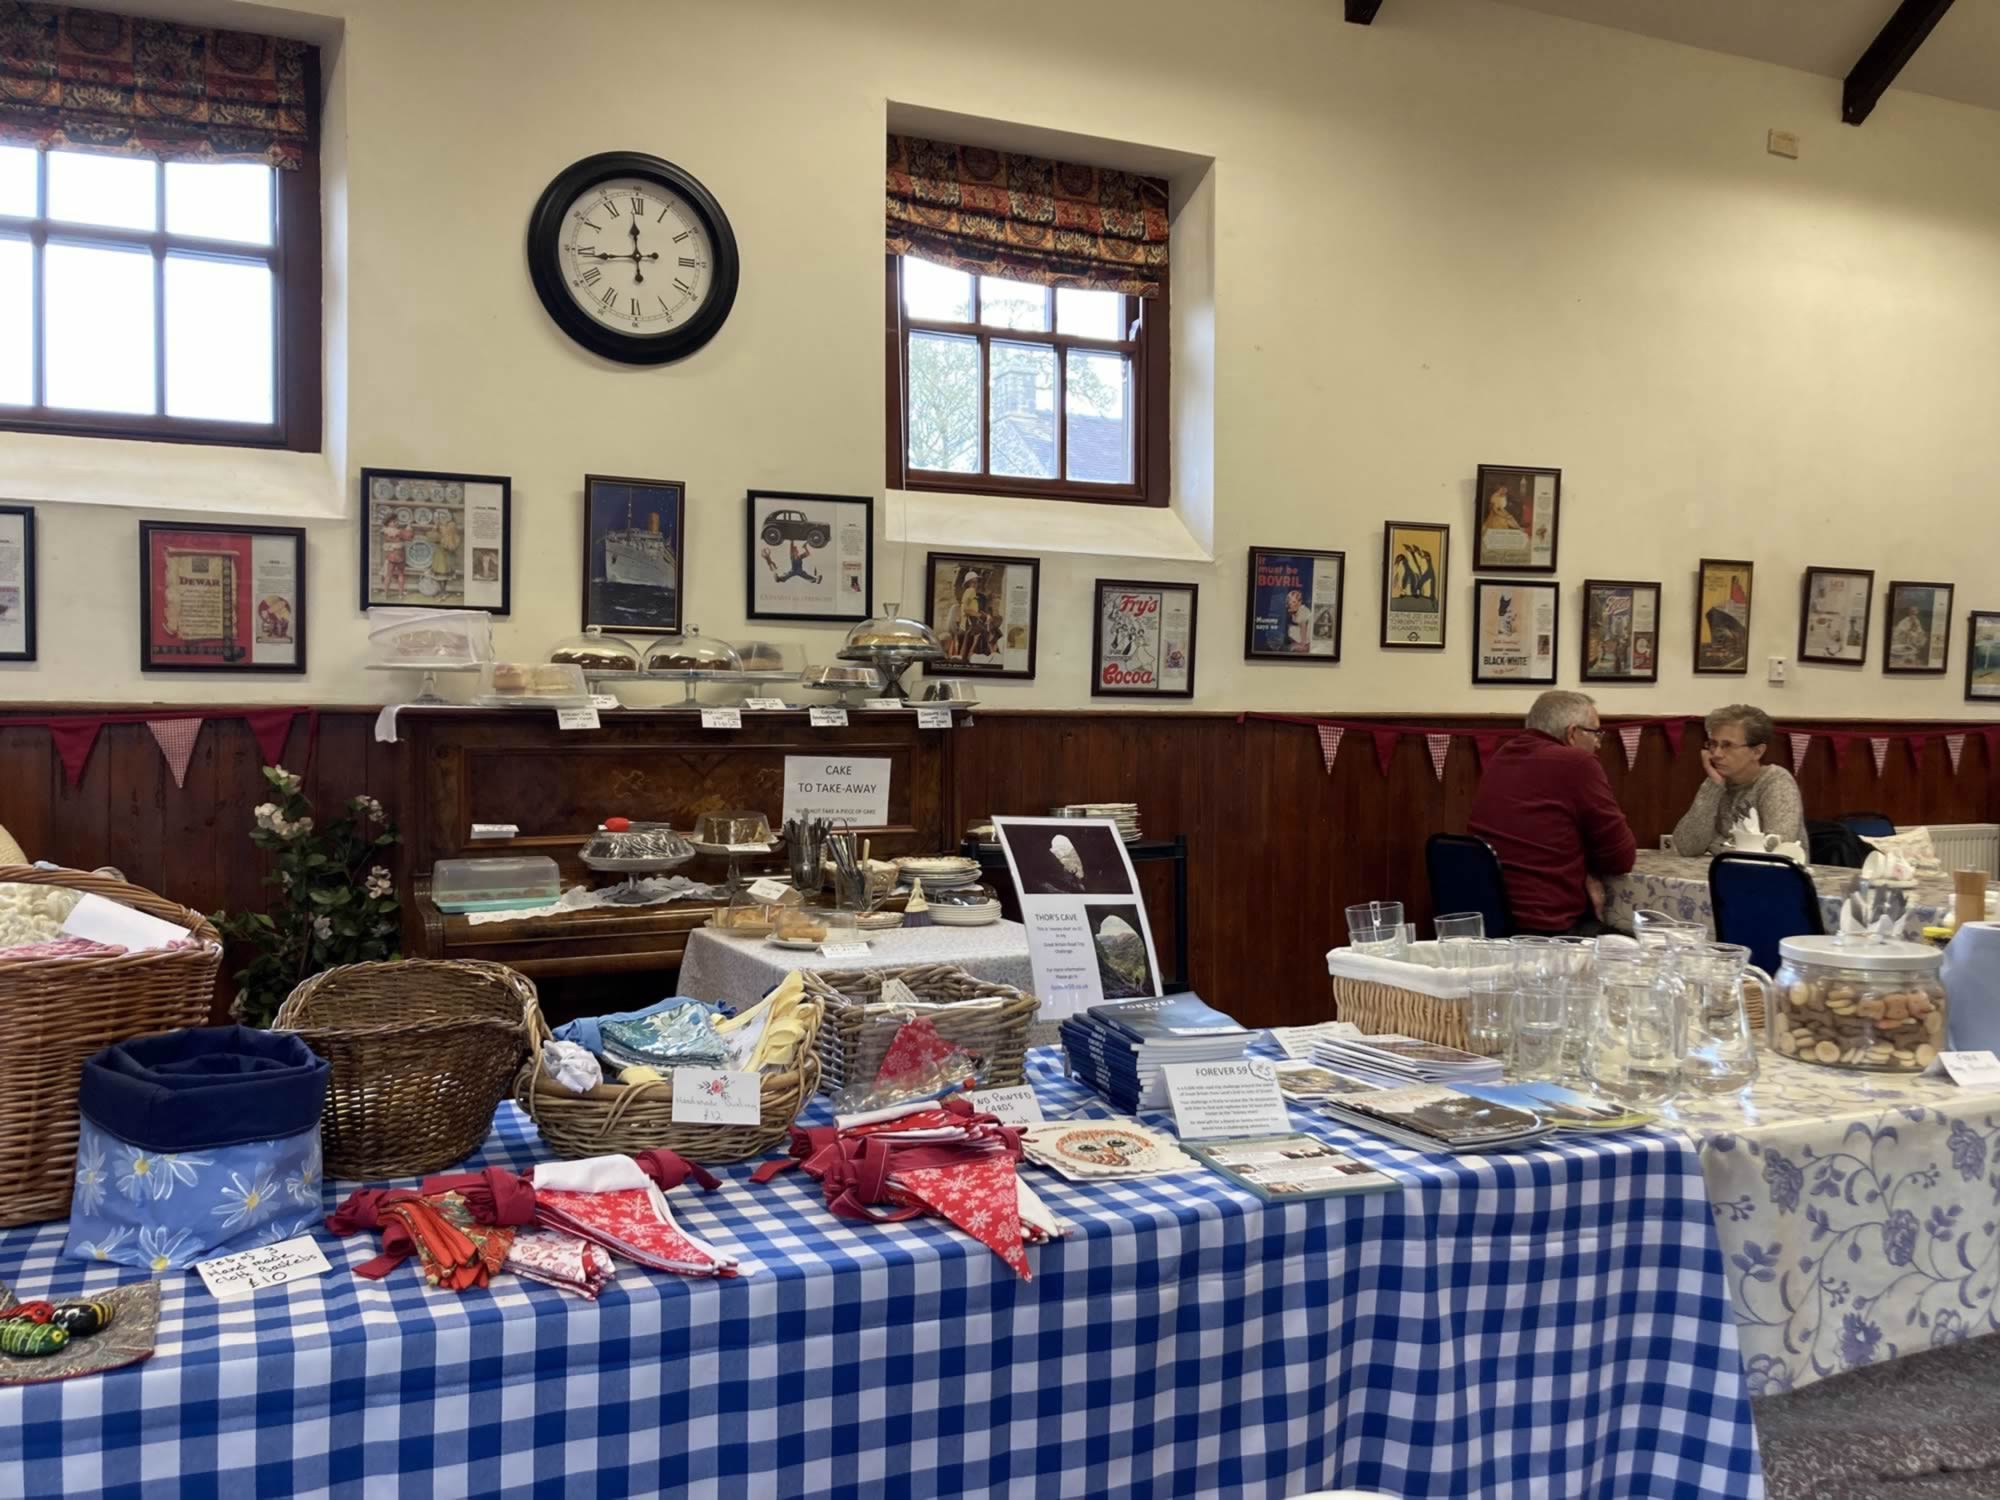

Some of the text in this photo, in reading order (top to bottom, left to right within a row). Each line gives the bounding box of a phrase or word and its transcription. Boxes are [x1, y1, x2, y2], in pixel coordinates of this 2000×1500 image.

[630, 198, 644, 216] XII
[672, 230, 690, 244] II
[678, 256, 696, 268] III
[1258, 575, 1303, 588] BOVRIL
[1120, 594, 1159, 617] Fry's
[1484, 656, 1505, 666] BLACK
[1102, 662, 1153, 685] Cocoa
[825, 765, 852, 776] CAKE
[798, 782, 878, 794] TO TAKE-AWAY
[1034, 913, 1078, 922] THOR'S CAVE
[1119, 1000, 1176, 1010] FOREVER
[1195, 1067, 1236, 1078] FOREVER
[1236, 1066, 1248, 1076] 59
[992, 1091, 1032, 1102] PAINTED
[985, 1102, 1014, 1114] CARDS
[240, 1252, 256, 1262] of
[264, 1247, 279, 1256] 3
[208, 1253, 295, 1278] Hand made
[258, 1254, 318, 1274] Baskets
[248, 1271, 288, 1289] £10
